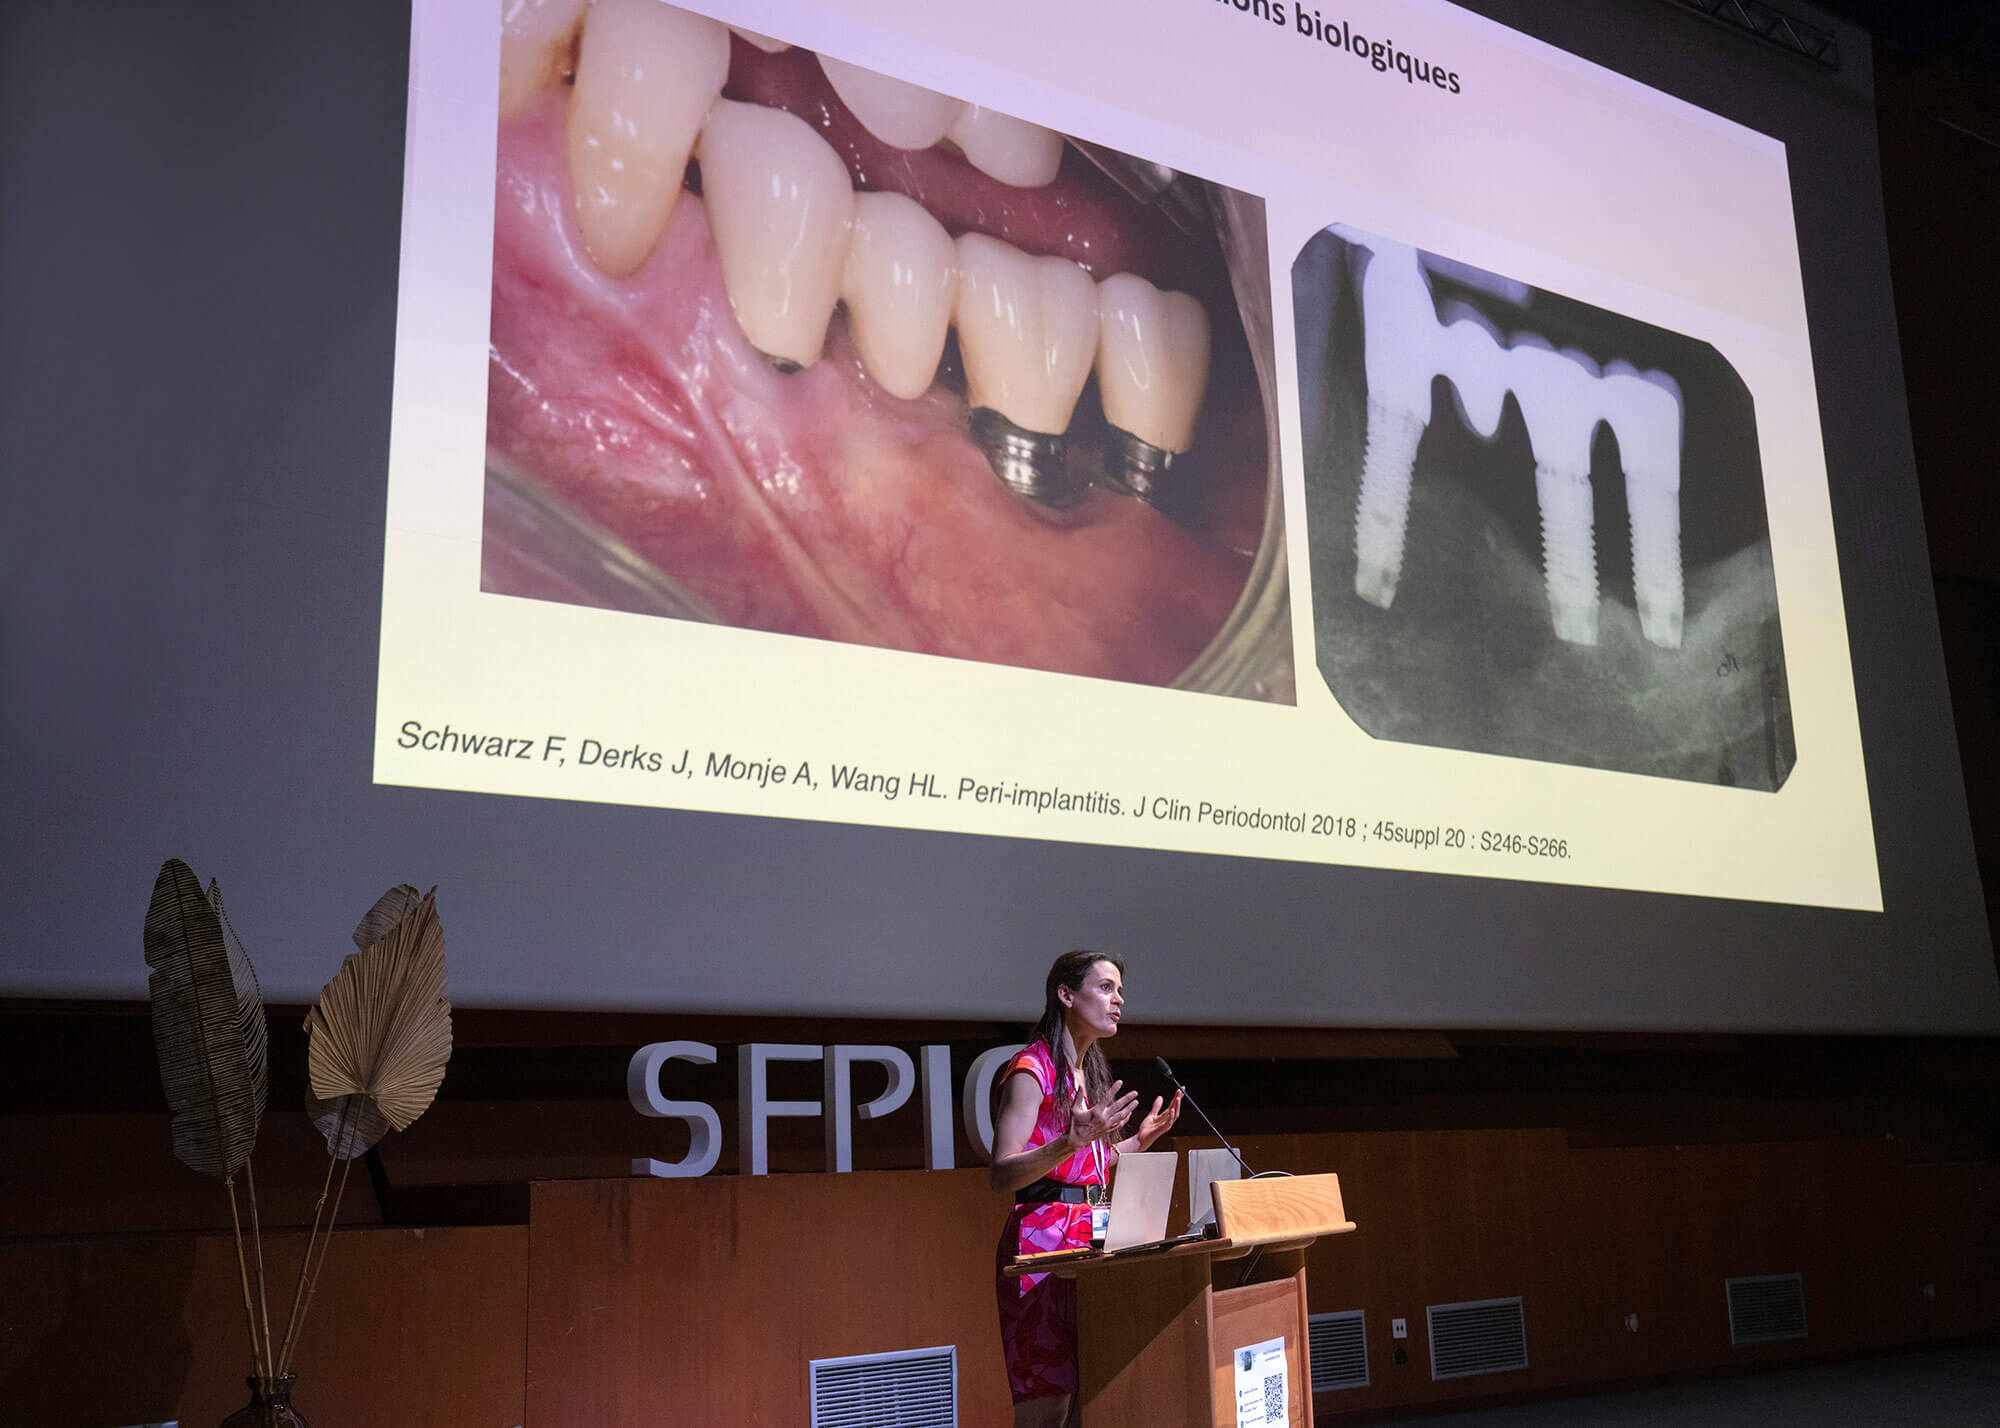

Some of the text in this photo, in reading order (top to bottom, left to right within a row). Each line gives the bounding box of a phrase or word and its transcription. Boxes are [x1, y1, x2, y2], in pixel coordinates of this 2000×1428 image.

[1295, 2, 1460, 94] biologiques
[397, 721, 534, 759] Schwarz
[543, 736, 567, 765] F,
[579, 739, 662, 773] Derks
[671, 750, 692, 779] J,
[705, 752, 787, 788] Monje
[791, 762, 818, 790] A,
[832, 764, 900, 800] Wang
[909, 773, 947, 798] HL.
[958, 778, 1125, 815] Peri-implantitis.
[1133, 796, 1145, 818] J
[1153, 797, 1190, 822] Clin
[1198, 802, 1306, 832] Periodontol
[1311, 813, 1356, 838] 2018
[1373, 821, 1440, 851] 45suppl
[1445, 828, 1465, 848] 20
[1481, 831, 1572, 859] S246-S266.
